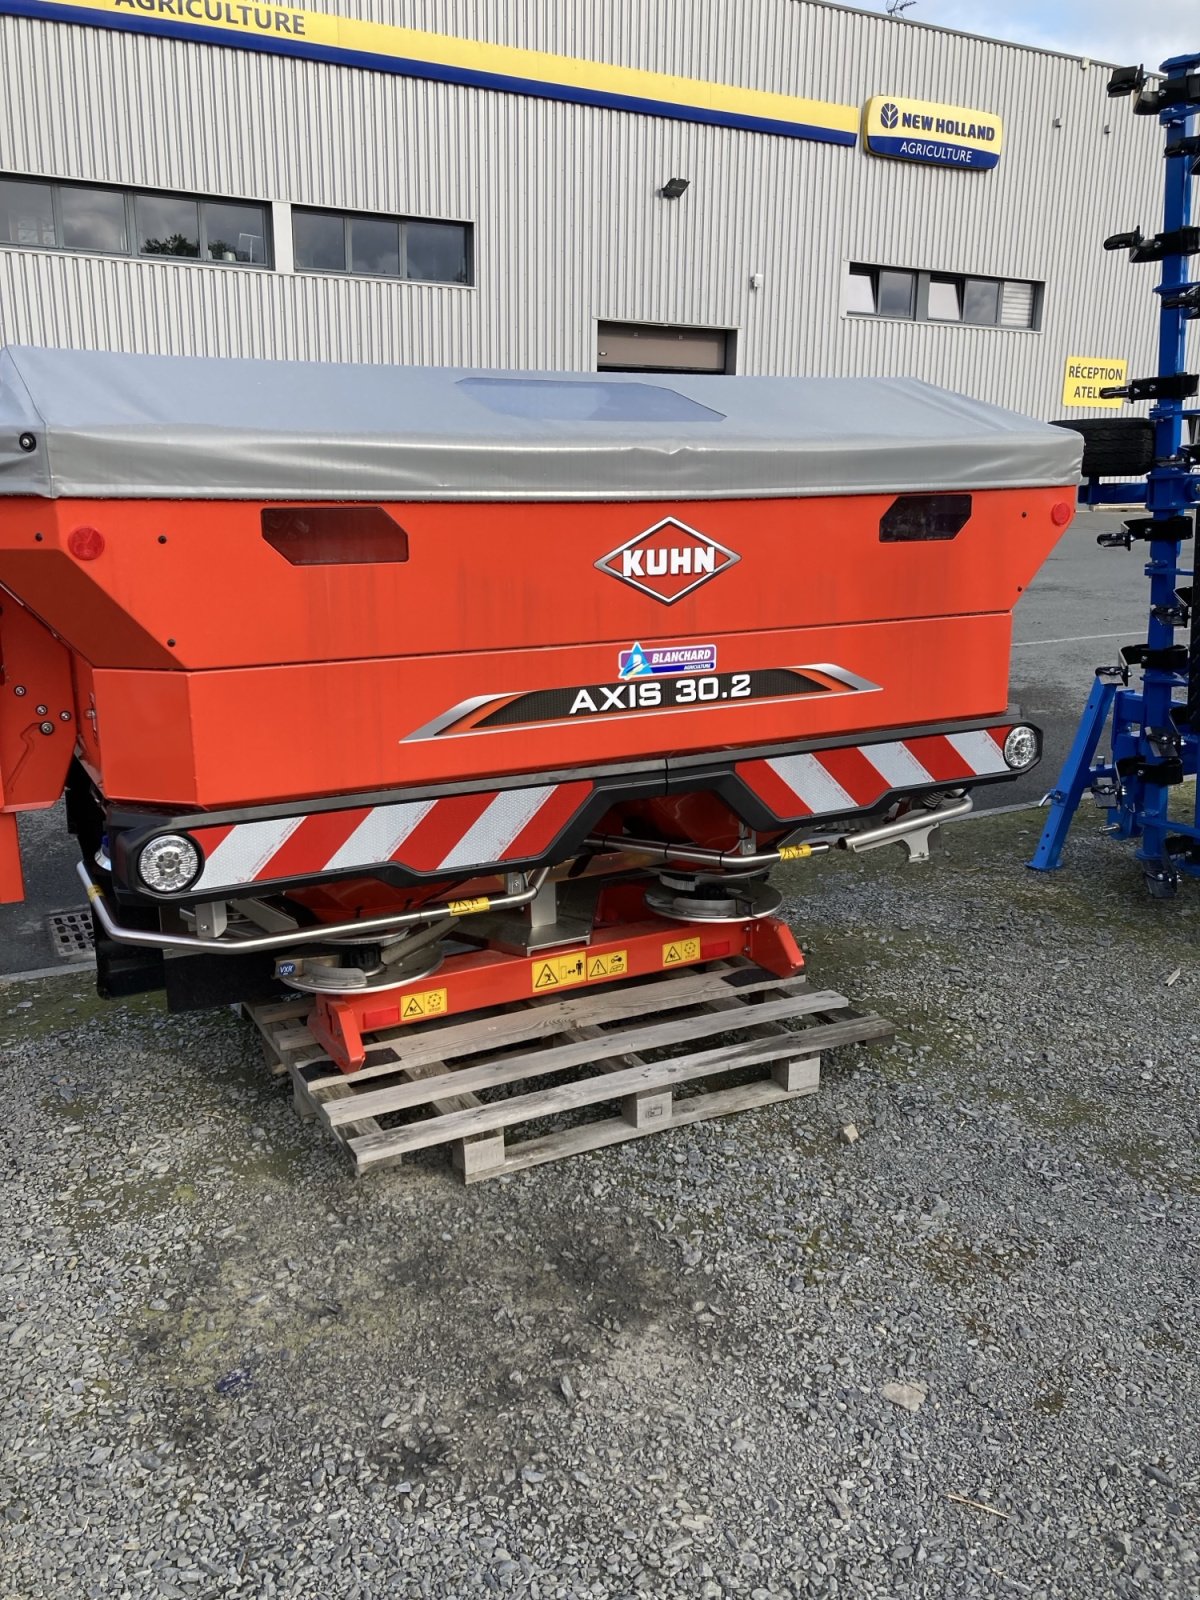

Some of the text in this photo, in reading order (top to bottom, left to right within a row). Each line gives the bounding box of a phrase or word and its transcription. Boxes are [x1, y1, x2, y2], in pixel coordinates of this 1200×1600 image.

[902, 112, 995, 141] NEW HOLLAND
[900, 141, 973, 162] AGRICULTURE
[1068, 363, 1123, 380] RÉCEPTION
[622, 546, 715, 577] KUHN
[651, 649, 712, 664] BLANCHARD
[569, 674, 751, 714] AXIS 30.2
